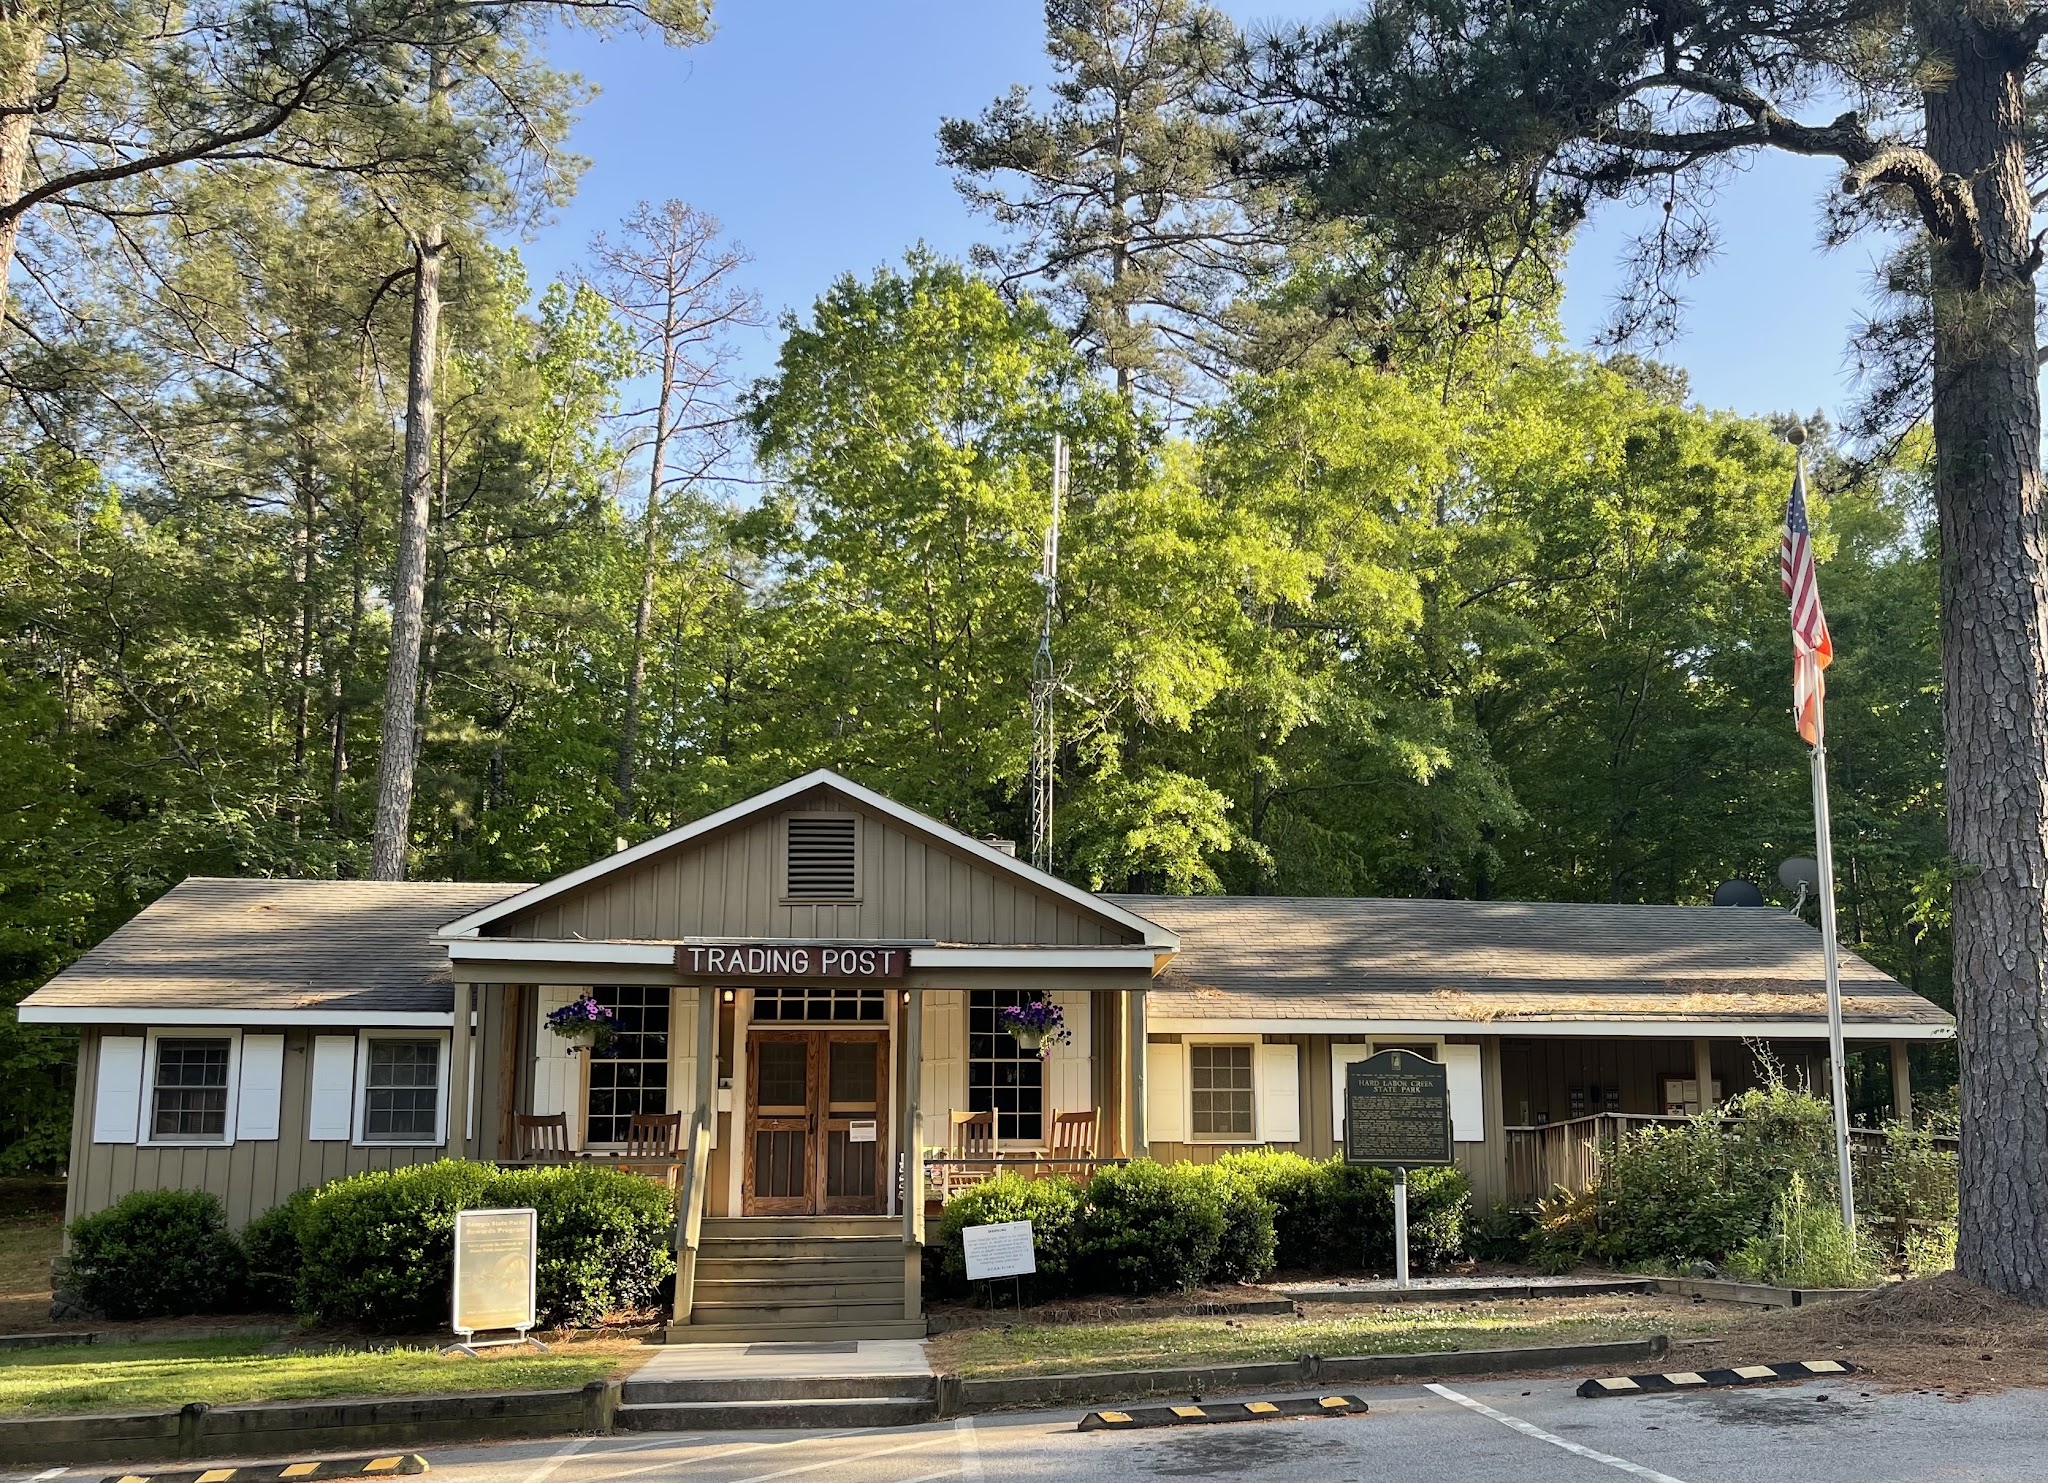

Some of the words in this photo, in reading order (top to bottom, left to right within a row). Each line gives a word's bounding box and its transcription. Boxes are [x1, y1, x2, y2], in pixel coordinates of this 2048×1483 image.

[687, 948, 809, 974] TRADING
[821, 949, 896, 974] POST
[1358, 1079, 1380, 1087] HARD
